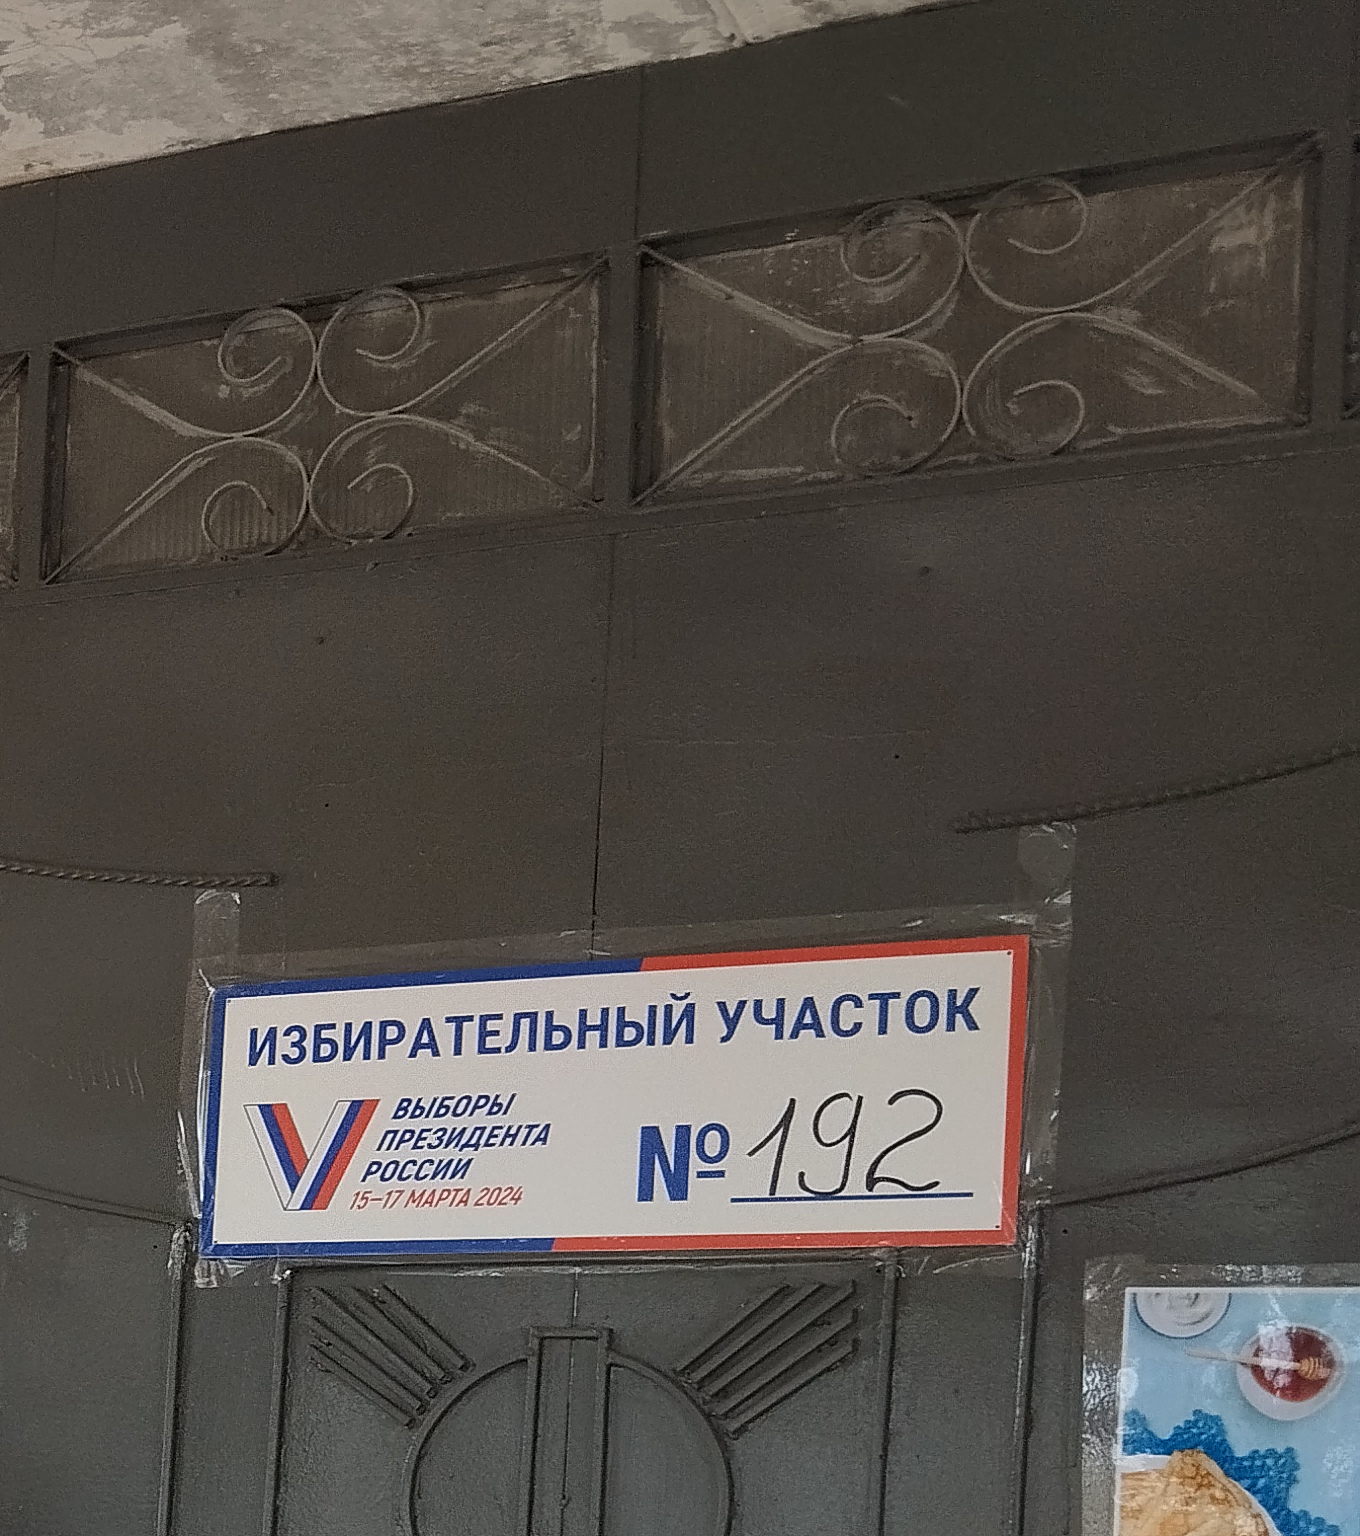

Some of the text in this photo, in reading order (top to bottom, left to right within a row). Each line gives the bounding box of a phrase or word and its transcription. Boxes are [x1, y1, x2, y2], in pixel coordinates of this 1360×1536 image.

[248, 987, 981, 1066] ИЗБИРАТЕЛЬНЫЙ УЧАСТОК
[392, 1093, 517, 1120] ВЫБОРЫ
[376, 1123, 551, 1151] ПРЕЗИДЕНТА
[746, 1088, 944, 1197] 192
[361, 1158, 474, 1182] РОССИИ
[637, 1122, 730, 1202] №
[404, 1187, 472, 1208] МАРТА
[474, 1186, 523, 1206] 2024
